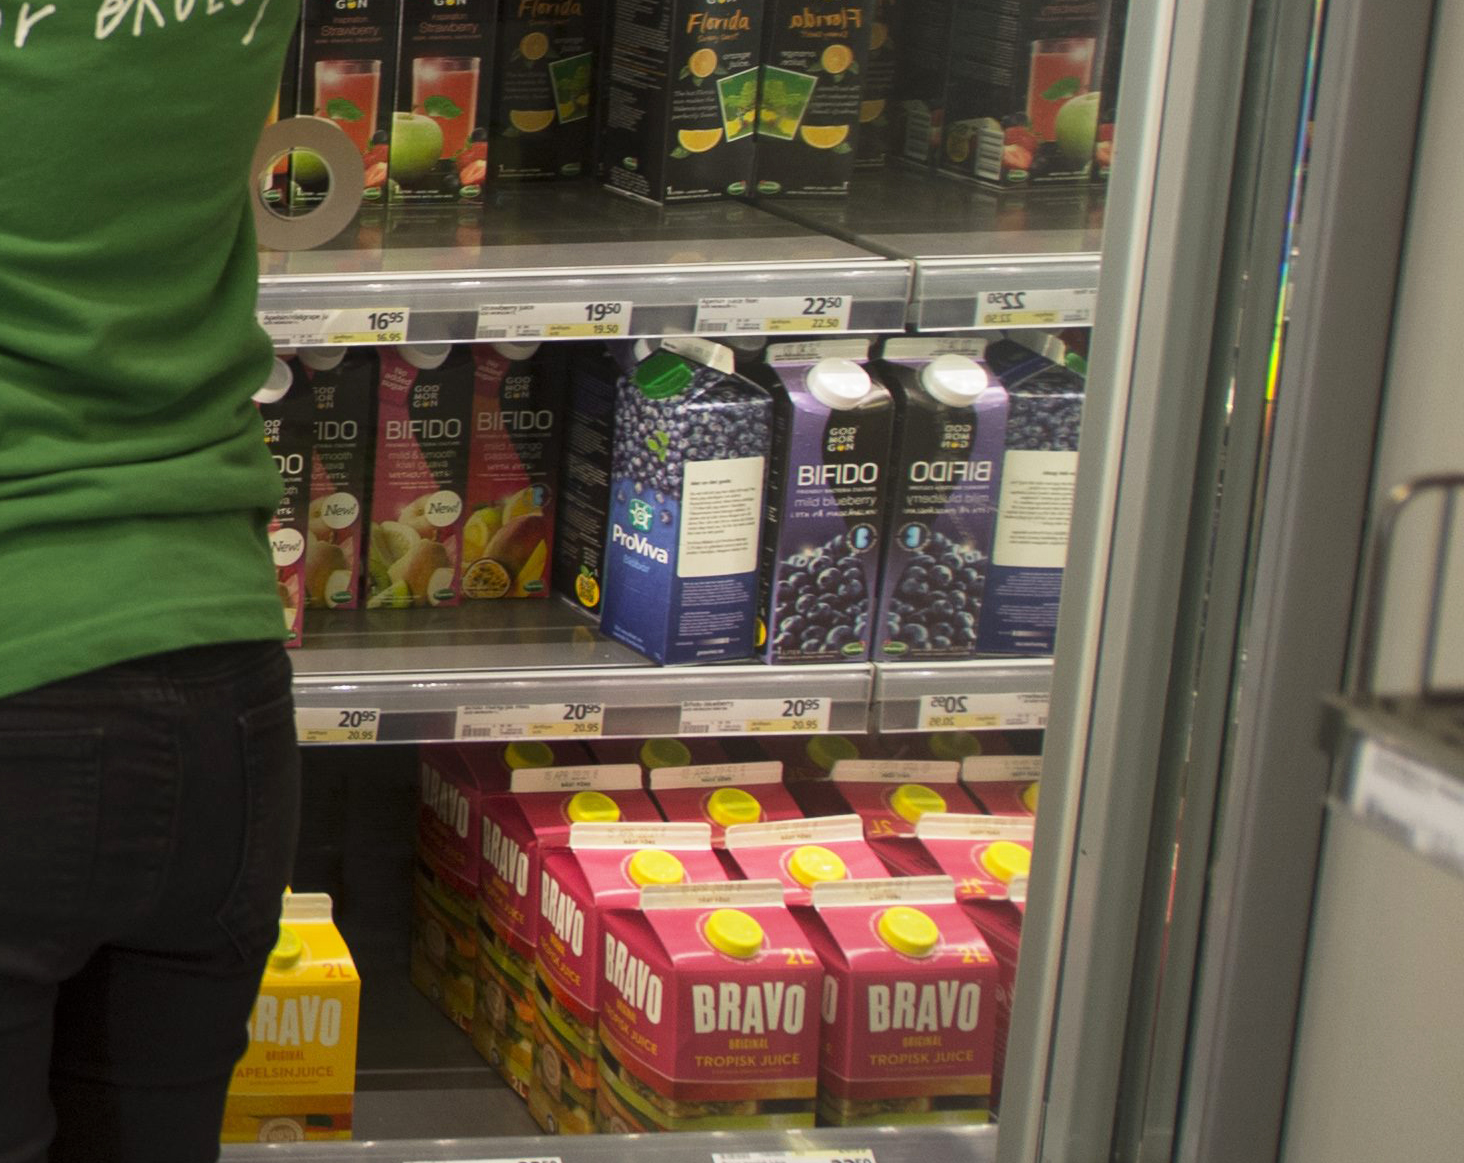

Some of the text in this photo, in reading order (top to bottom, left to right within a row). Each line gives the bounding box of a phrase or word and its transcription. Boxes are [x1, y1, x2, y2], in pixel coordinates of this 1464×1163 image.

[687, 11, 751, 35] Florida
[385, 418, 462, 440] BIFIDO
[477, 409, 553, 431] BIFIDO
[830, 427, 857, 436] GOD
[797, 463, 878, 486] BIFIDO
[324, 502, 356, 518] New!
[427, 500, 461, 516] New!
[612, 523, 669, 564] ProViva
[482, 814, 530, 897] BRAVO
[540, 869, 585, 957] BRAVO
[784, 947, 815, 965] 2L
[961, 947, 989, 964] 2L
[321, 962, 353, 979] 2L
[604, 932, 663, 1025] BRAVO
[692, 980, 807, 1035] BRAVO
[867, 979, 981, 1033] BRAVO
[728, 1038, 769, 1050] ORIGINAL
[902, 1035, 942, 1048] ORIGINAL
[265, 1050, 305, 1062] ORIGINAL
[695, 1052, 802, 1067] TROPISK JUICE
[869, 1051, 975, 1066] TROPISK JUICE
